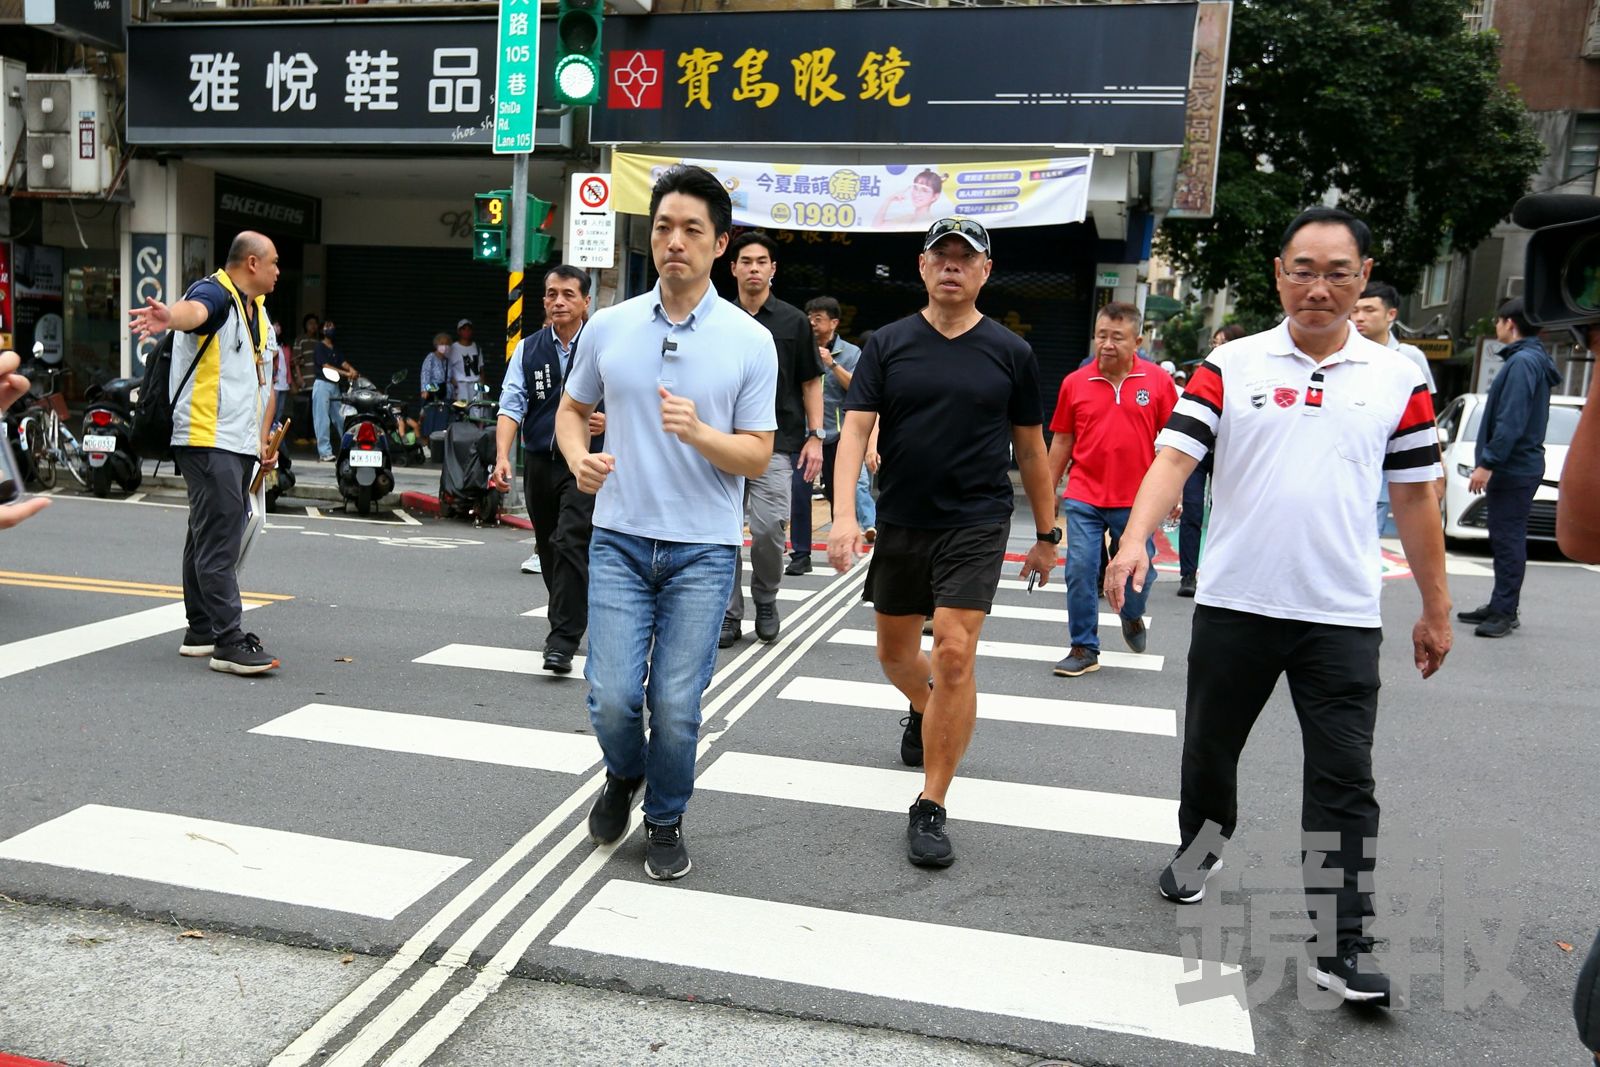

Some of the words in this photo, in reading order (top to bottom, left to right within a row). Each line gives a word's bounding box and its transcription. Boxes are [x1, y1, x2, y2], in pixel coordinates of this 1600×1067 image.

[188, 47, 482, 113] 雅悅鞋品
[676, 46, 912, 110] 寶島眼鏡
[499, 101, 521, 115] ShiDa
[451, 125, 477, 141] shoe
[497, 118, 510, 131] Rd.
[497, 134, 515, 147] Lane
[516, 132, 531, 147] 105
[756, 168, 882, 202] 今夏最萌蕉點
[220, 193, 305, 226] SKECHERS
[489, 199, 502, 225] 9
[793, 201, 856, 228] 1980
